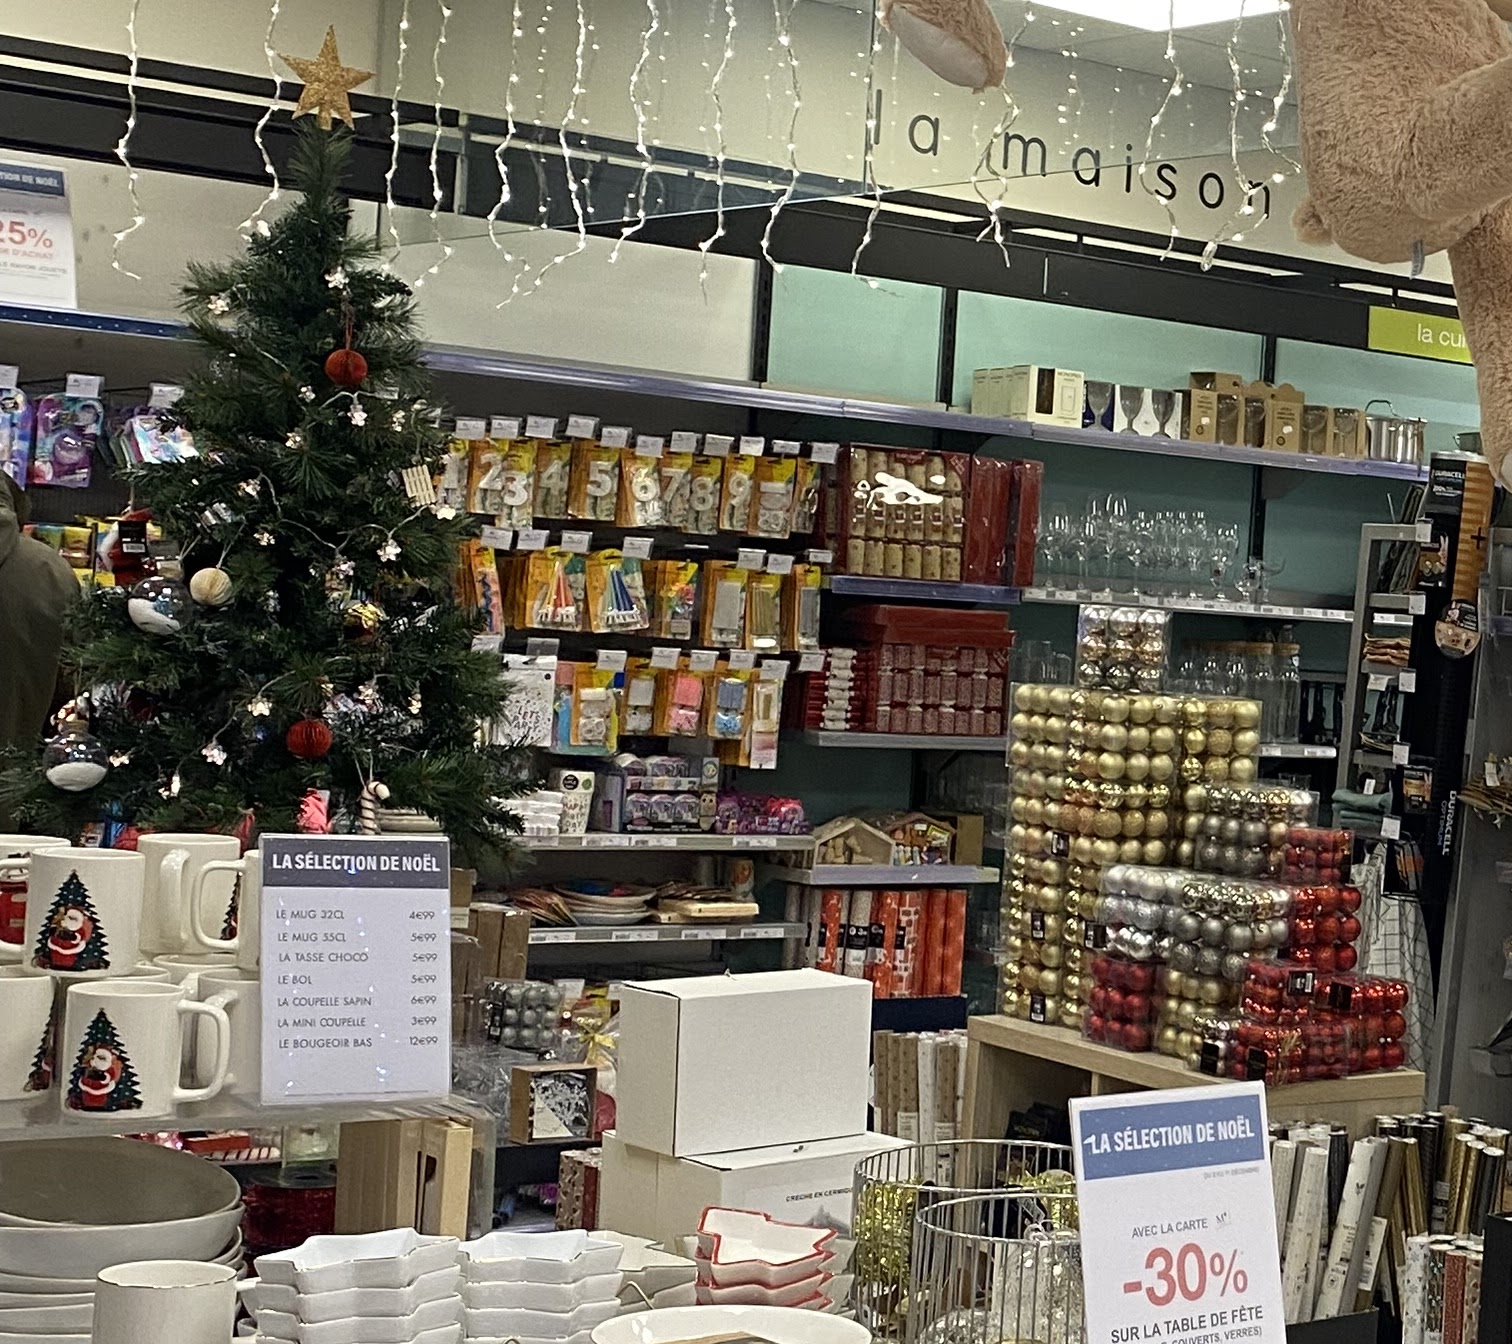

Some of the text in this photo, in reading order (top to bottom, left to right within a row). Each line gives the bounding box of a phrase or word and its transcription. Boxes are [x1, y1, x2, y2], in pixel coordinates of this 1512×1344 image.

[874, 89, 1271, 218] la maison
[1416, 323, 1434, 344] la
[1442, 790, 1457, 855] DURACELL
[272, 851, 441, 872] LA SÉLECTION DE NOËL
[276, 910, 286, 919] LE
[291, 910, 317, 920] MUG
[409, 911, 435, 920] 4€99
[277, 933, 288, 942] LE
[292, 933, 318, 942] MUG
[410, 933, 437, 942] 5€99
[279, 952, 438, 963] LA TASSE CHOCO 5€99
[278, 974, 437, 985] LE BOL 5€99
[278, 995, 437, 1007] LA COUPELLE SAPIN 6€99
[278, 1016, 437, 1028] LA MINI COUPELLE 3€99
[279, 1036, 438, 1048] LE BOUGEOIR BAS 12€99
[1089, 1115, 1256, 1155] LA SÉLECTION DE NOËL
[1131, 1224, 1158, 1238] AVEC
[1160, 1222, 1174, 1234] LA
[1175, 1218, 1208, 1233] CARTE
[1123, 1242, 1248, 1307] -30%
[1111, 1305, 1264, 1344] SUR LA TABLE DE FÊTE
[1224, 1326, 1263, 1341] VERRES)
